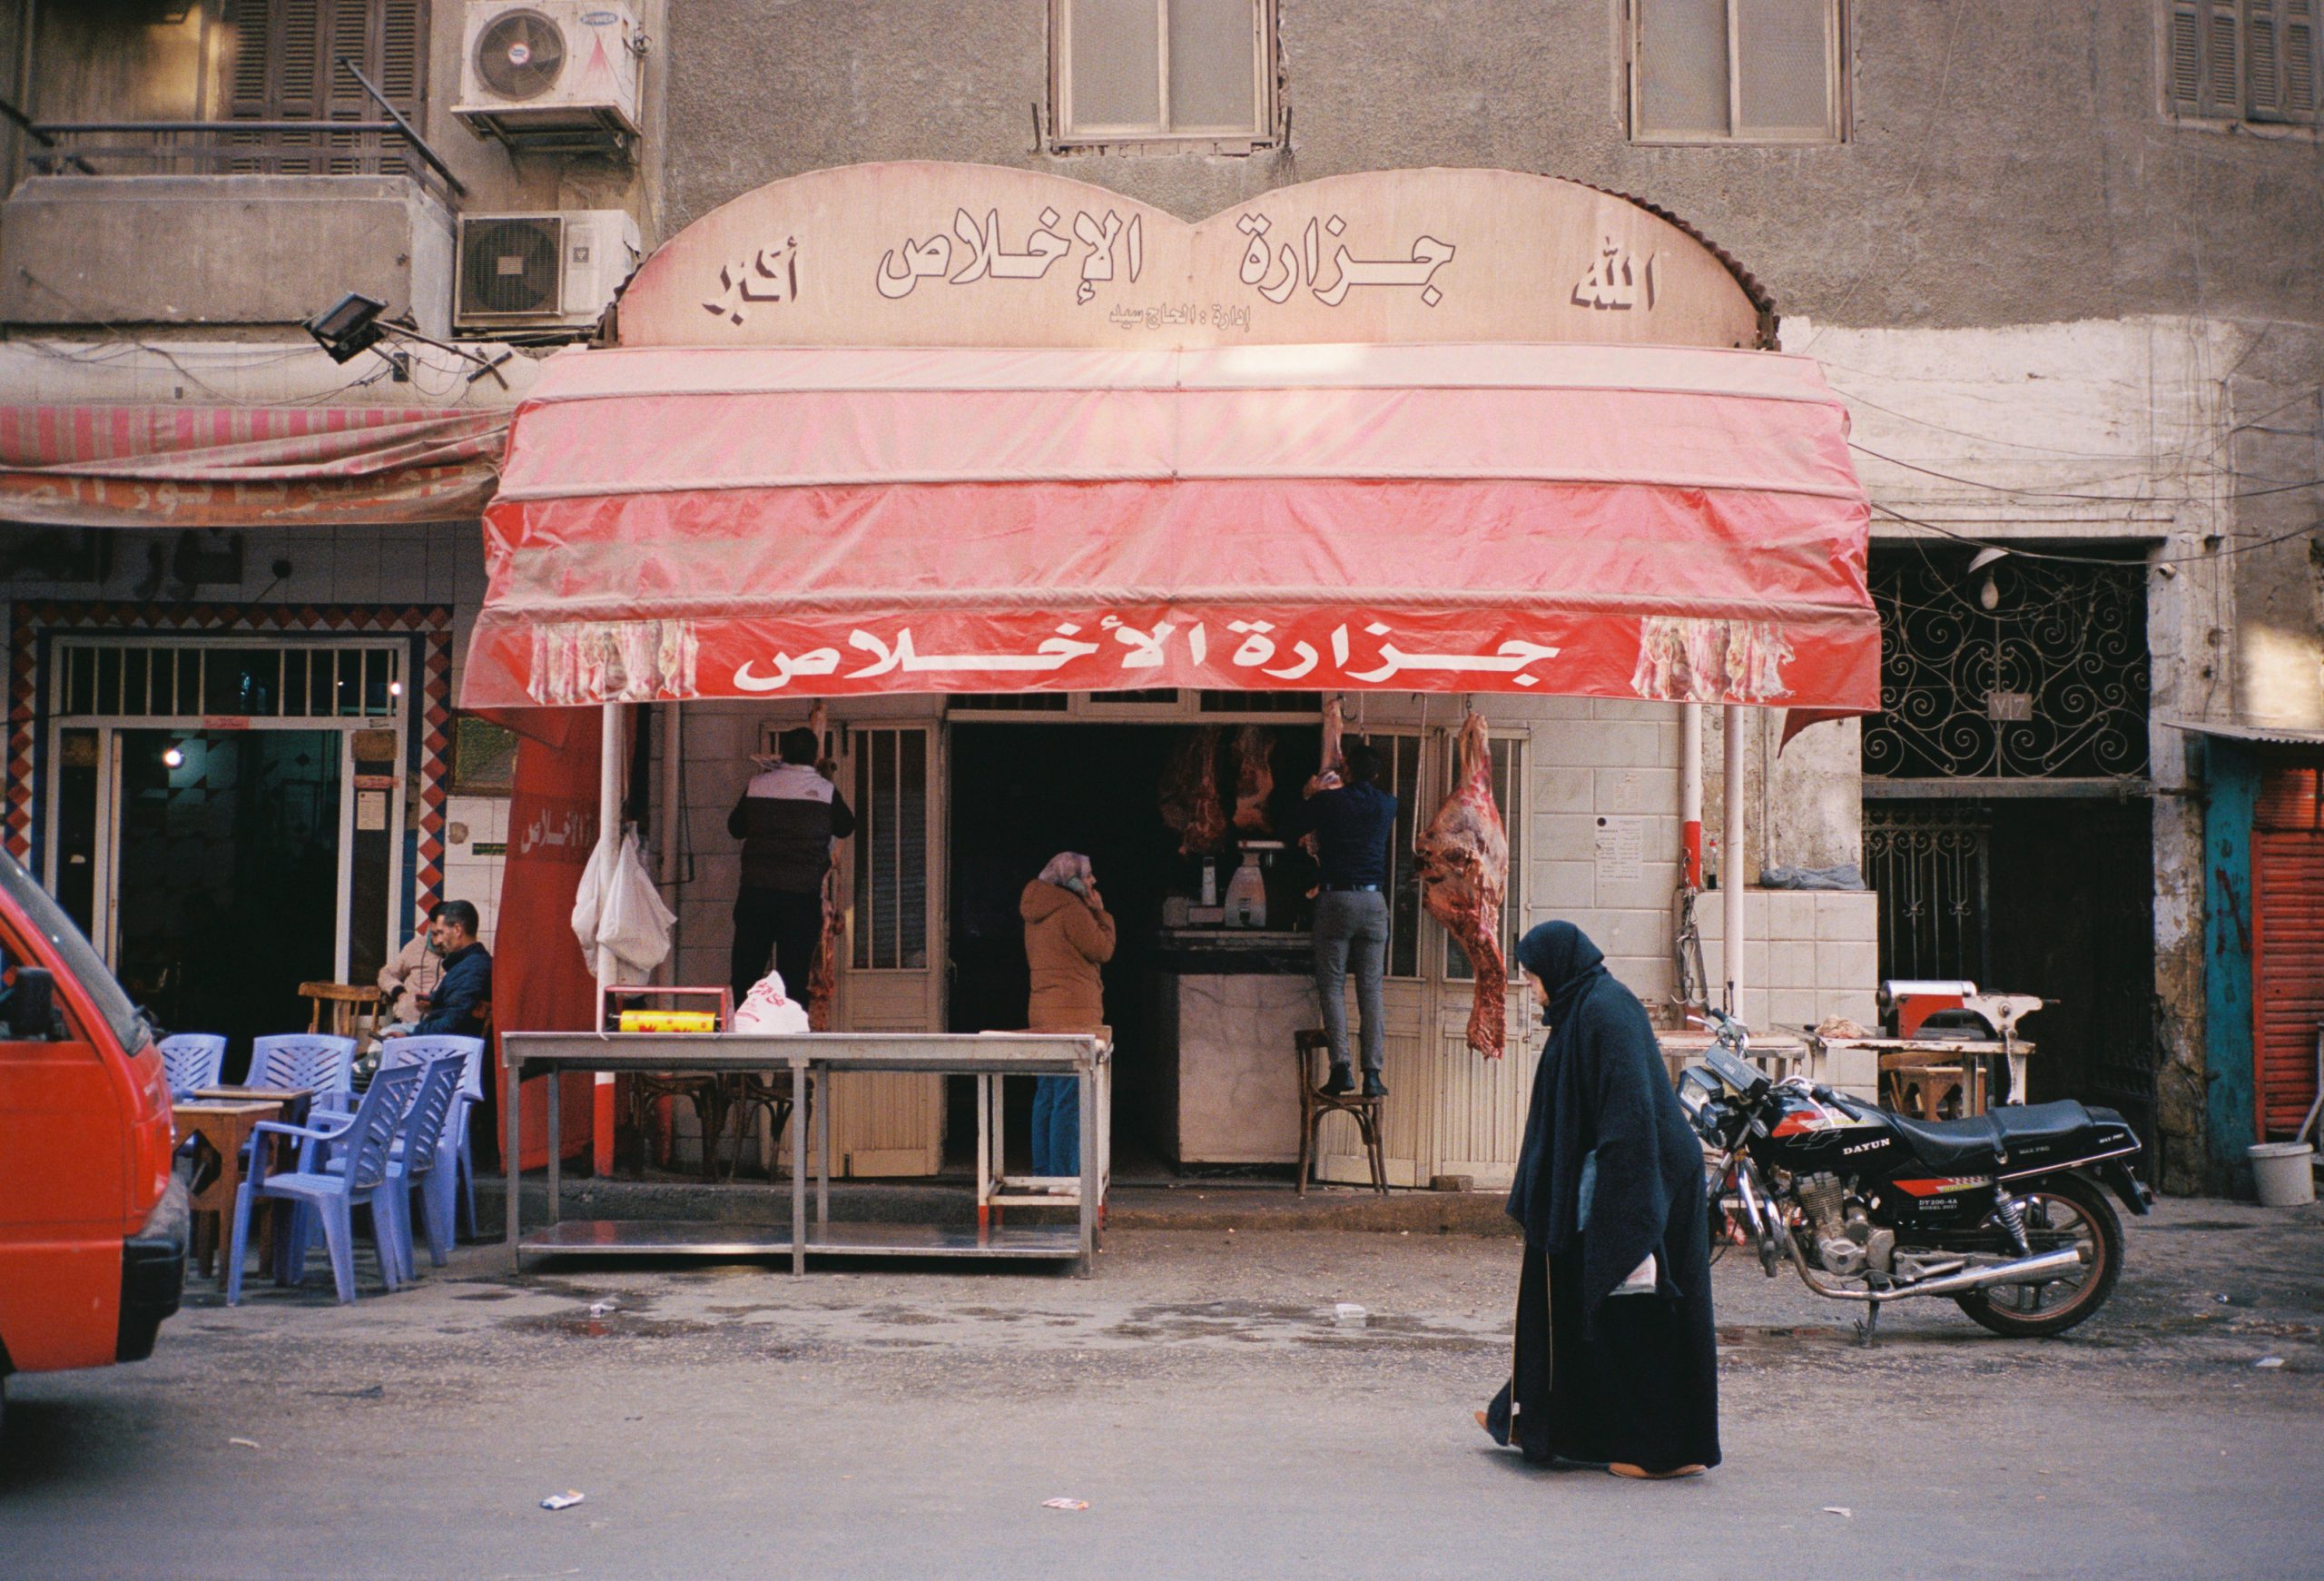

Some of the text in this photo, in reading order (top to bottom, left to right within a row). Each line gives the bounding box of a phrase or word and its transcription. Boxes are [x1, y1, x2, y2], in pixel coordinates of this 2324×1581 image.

[582, 14, 616, 24] POWER
[876, 206, 1456, 307] جزارة الإخلاص
[701, 235, 799, 326] أكبر
[1108, 303, 1144, 330] سيد
[1146, 302, 1196, 330] الحاج
[1226, 619, 1561, 687] جزارة
[1843, 1138, 1890, 1155] DAYUN
